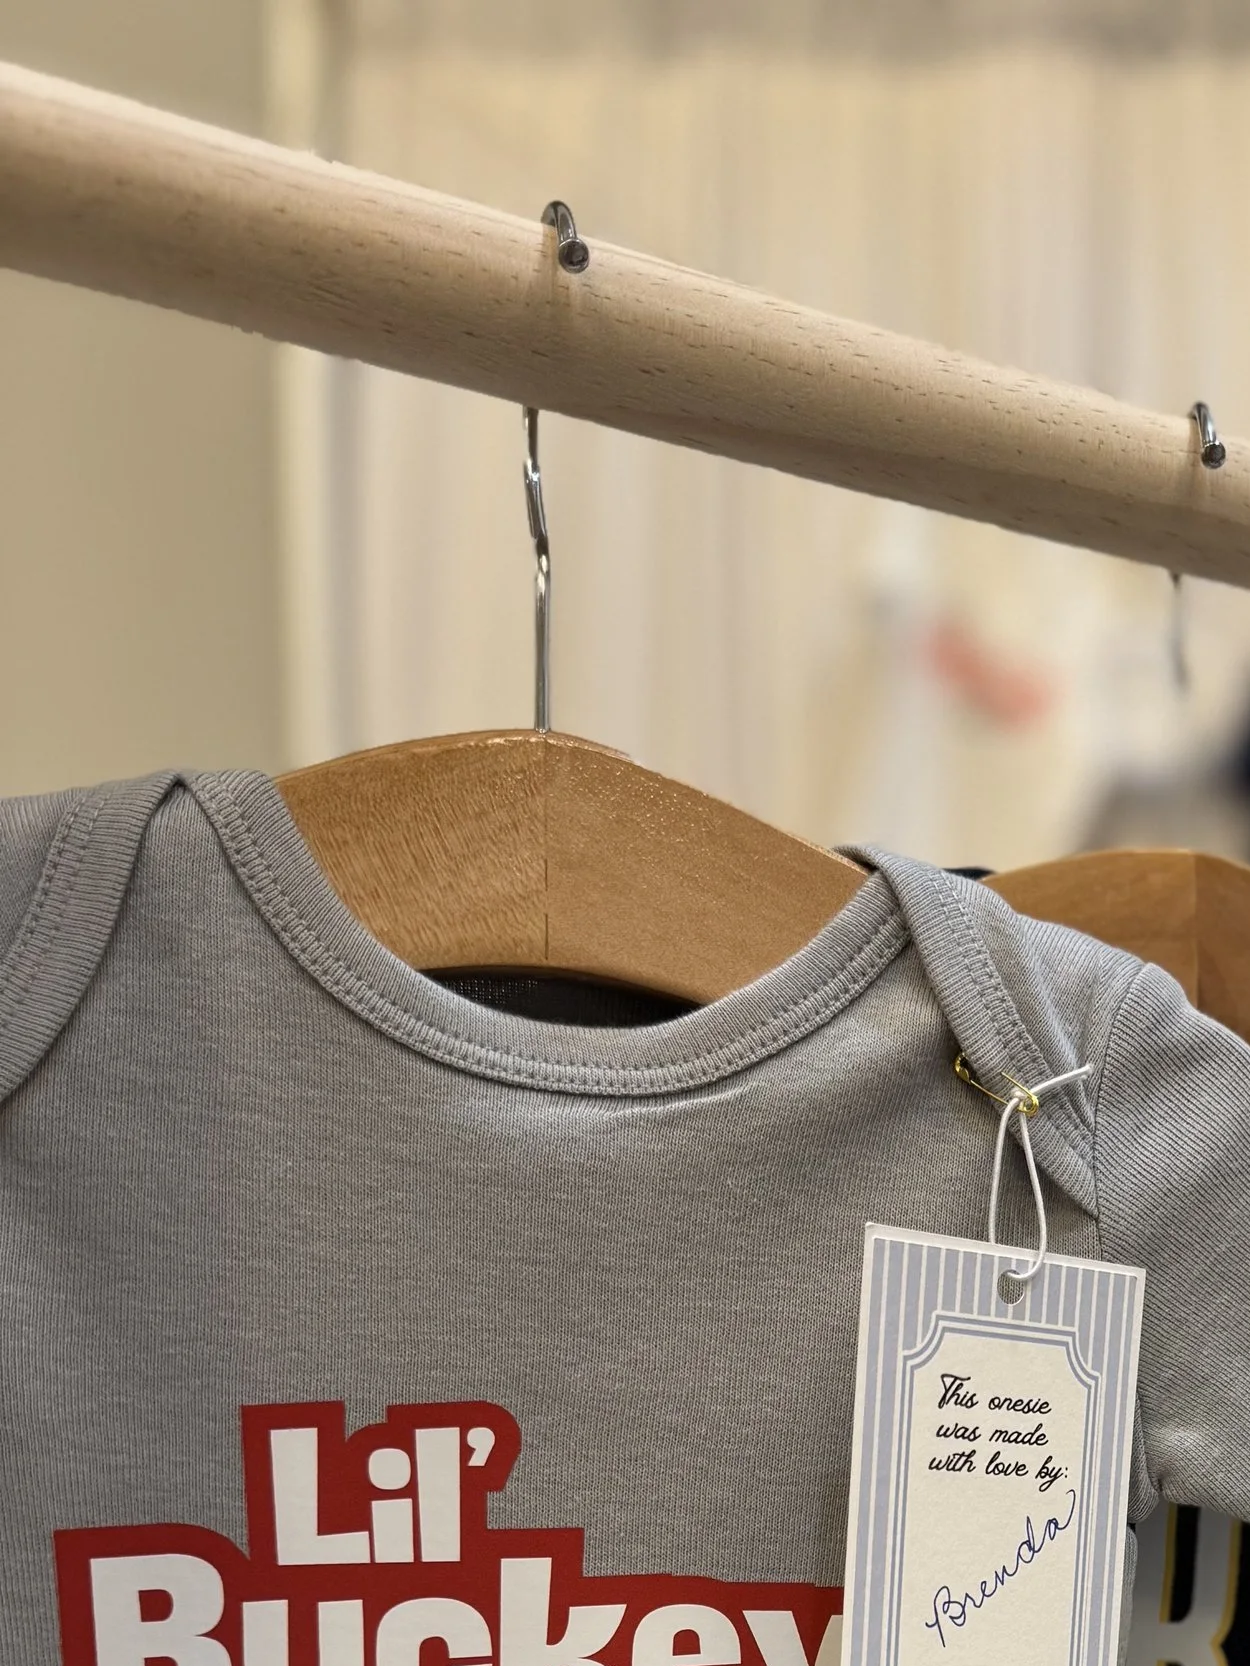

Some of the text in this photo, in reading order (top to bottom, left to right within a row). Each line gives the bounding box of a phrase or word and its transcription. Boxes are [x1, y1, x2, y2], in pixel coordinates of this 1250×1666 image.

[938, 1373, 1052, 1416] This onesie
[936, 1422, 1049, 1447] was made
[928, 1449, 1069, 1493] with love by:
[925, 1489, 1077, 1648] Brenda
